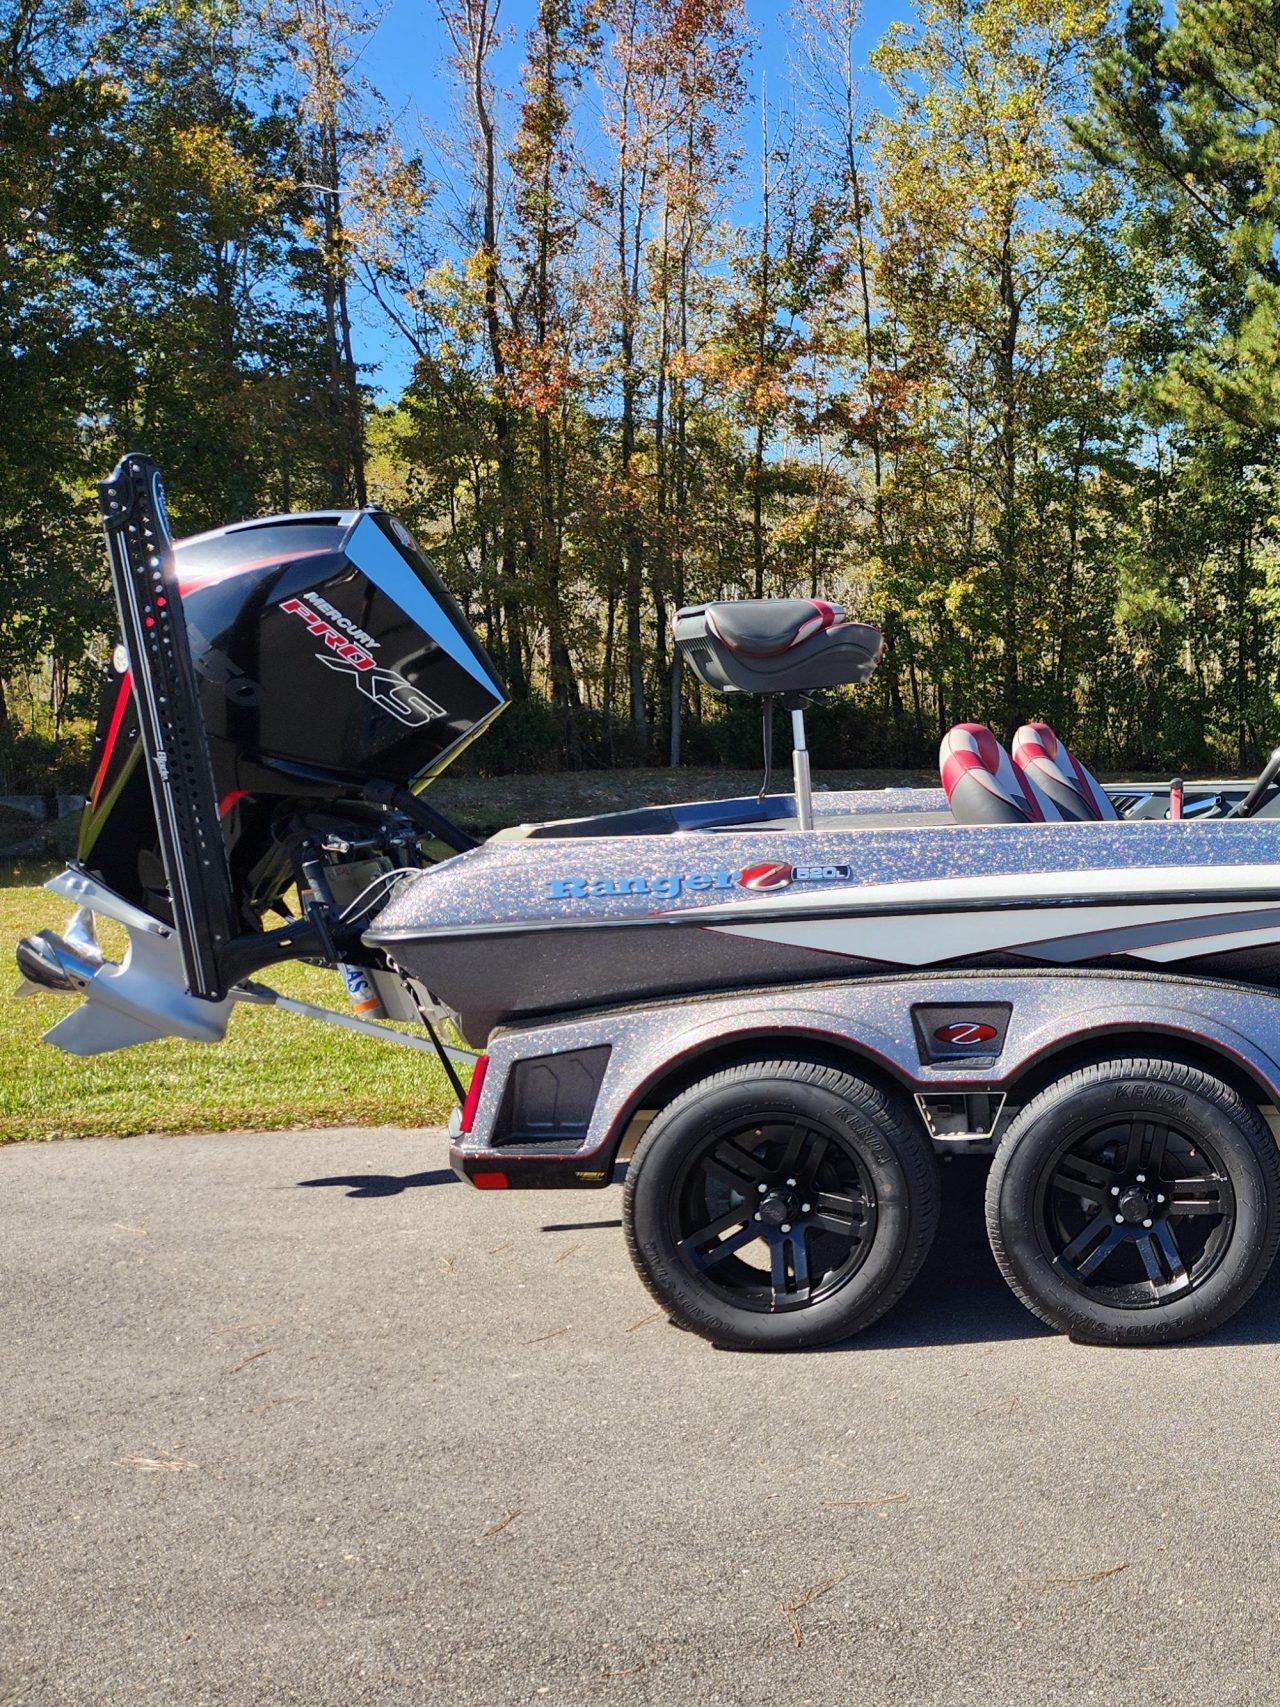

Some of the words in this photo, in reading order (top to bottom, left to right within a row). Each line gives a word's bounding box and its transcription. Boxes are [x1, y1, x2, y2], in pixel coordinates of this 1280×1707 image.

[279, 598, 376, 671] PRO
[303, 591, 381, 649] MERCURY
[315, 641, 447, 727] XS
[547, 869, 743, 899] Ranger
[1114, 1084, 1189, 1109] KENDA
